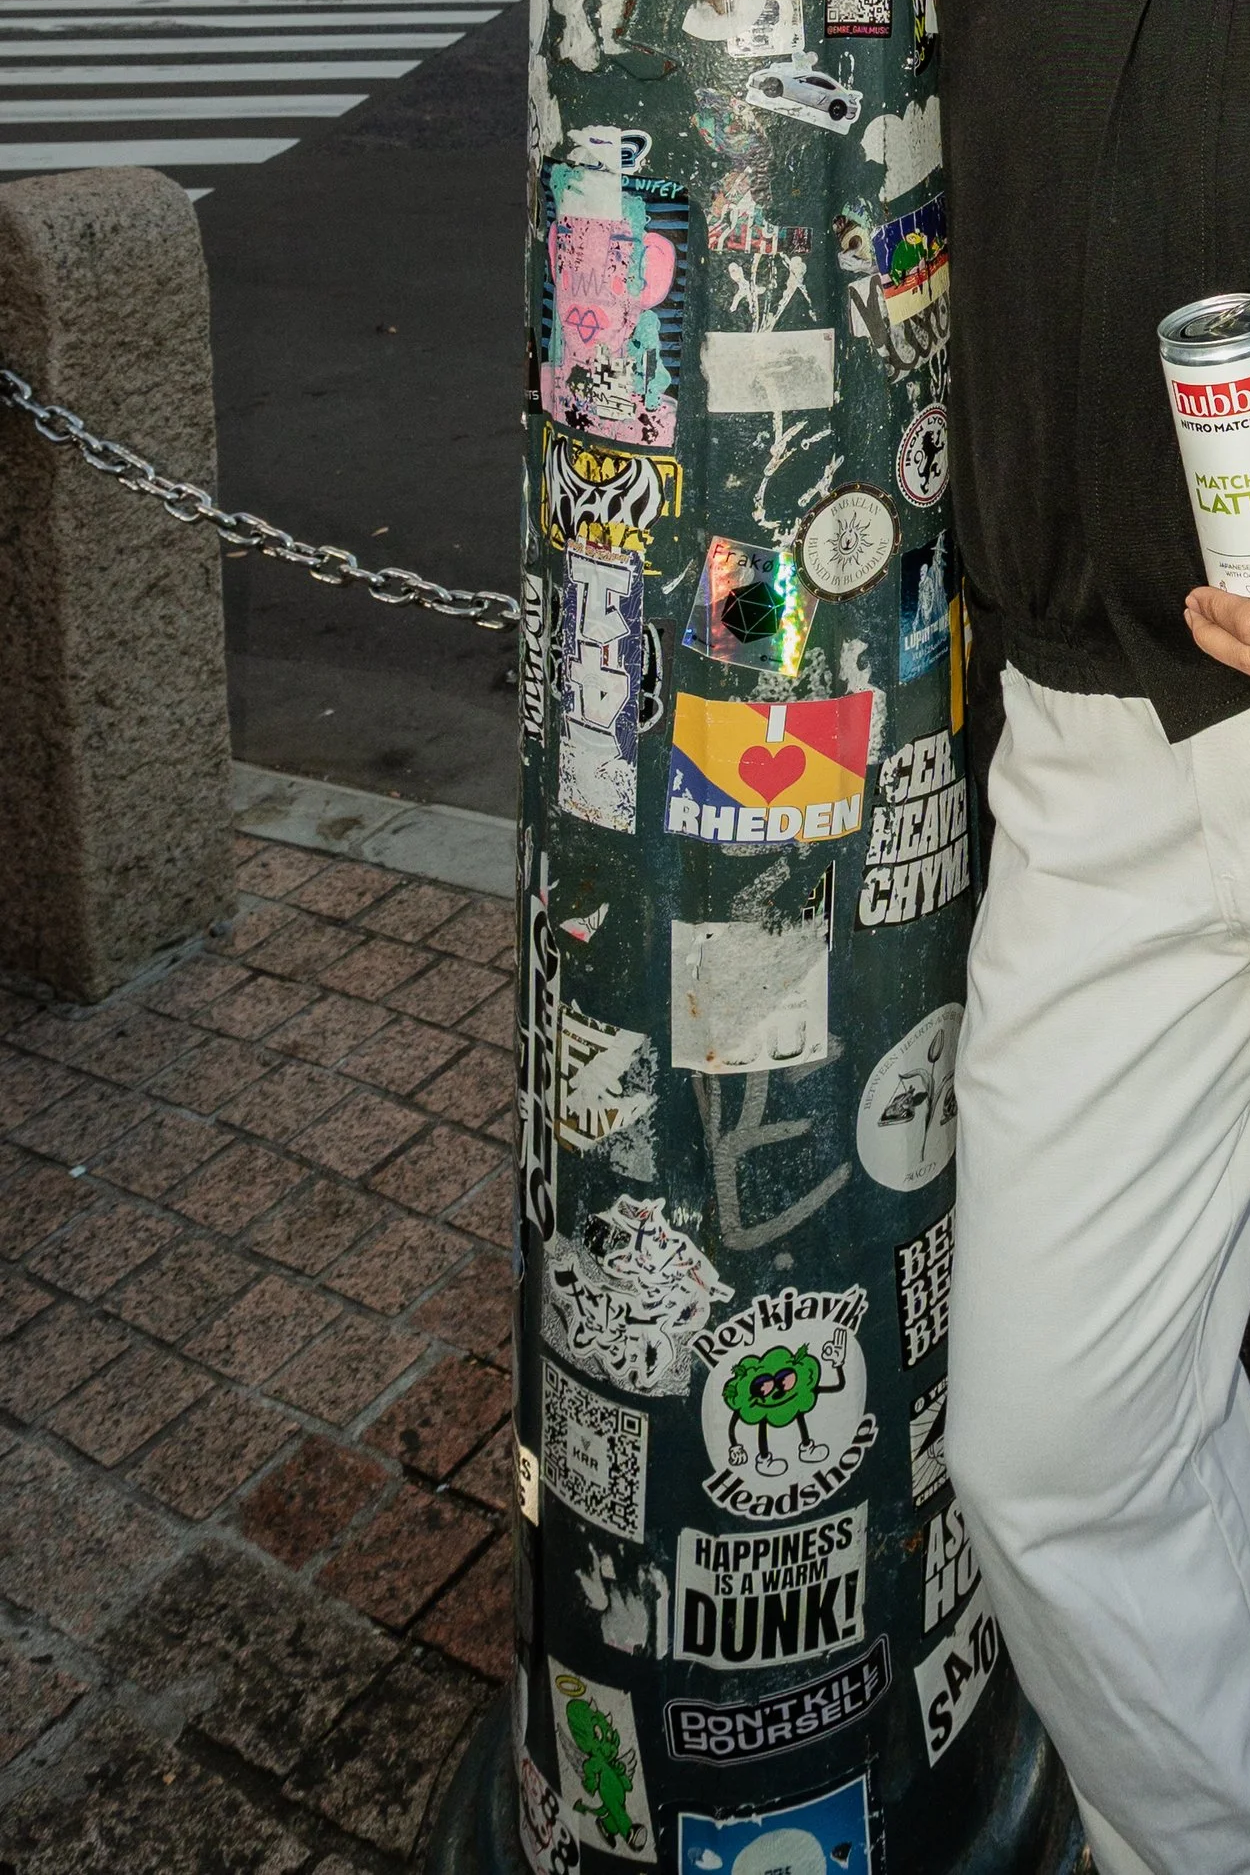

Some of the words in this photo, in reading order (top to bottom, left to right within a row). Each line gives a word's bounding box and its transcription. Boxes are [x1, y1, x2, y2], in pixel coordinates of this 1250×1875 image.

[635, 177, 685, 200] NIFEY
[905, 425, 924, 467] IRON
[1180, 419, 1212, 433] NITRO
[808, 537, 831, 581] BLESSED
[831, 574, 843, 586] BY
[843, 537, 890, 586] BLOODLINE
[1219, 562, 1250, 571] JAPANESE
[1225, 570, 1242, 578] WITH
[765, 705, 787, 743] I
[667, 793, 862, 843] RHEDEN
[864, 1054, 900, 1110] BETWEEN
[900, 1017, 935, 1055] HEARTS
[901, 1254, 951, 1327] BE
[692, 1289, 865, 1368] Reykjavík
[905, 1299, 950, 1366] BE
[707, 1418, 877, 1517] Headshop
[695, 1516, 854, 1573] HAPPINESS
[714, 1572, 734, 1596] IS
[741, 1571, 754, 1595] A
[762, 1557, 829, 1595] WARM
[682, 1569, 860, 1663] DUNK!
[802, 1659, 879, 1713] KILL
[684, 1675, 881, 1756] YOURSELF
